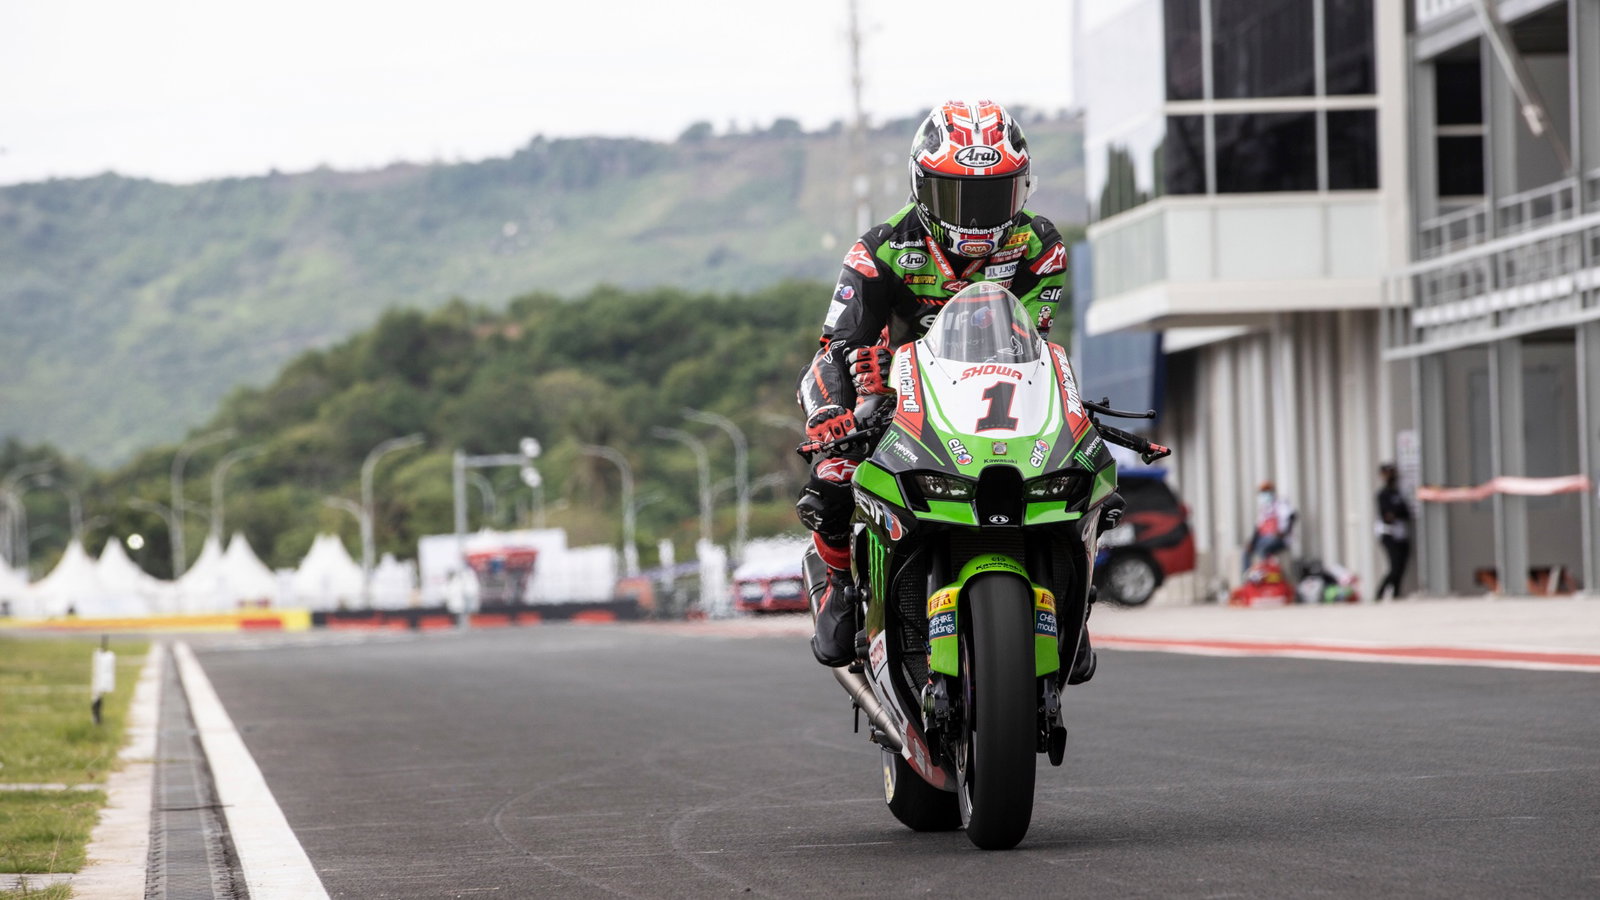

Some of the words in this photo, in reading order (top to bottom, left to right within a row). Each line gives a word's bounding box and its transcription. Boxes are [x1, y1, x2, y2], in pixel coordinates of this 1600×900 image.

[958, 148, 997, 162] Arai
[964, 244, 988, 253] PATA
[902, 254, 924, 266] Arai
[1040, 289, 1062, 301] elf
[960, 364, 1023, 381] SHOWA
[975, 381, 1019, 434] 1
[893, 441, 918, 463] MONSTER
[948, 438, 968, 456] elf
[1030, 445, 1045, 468] elf
